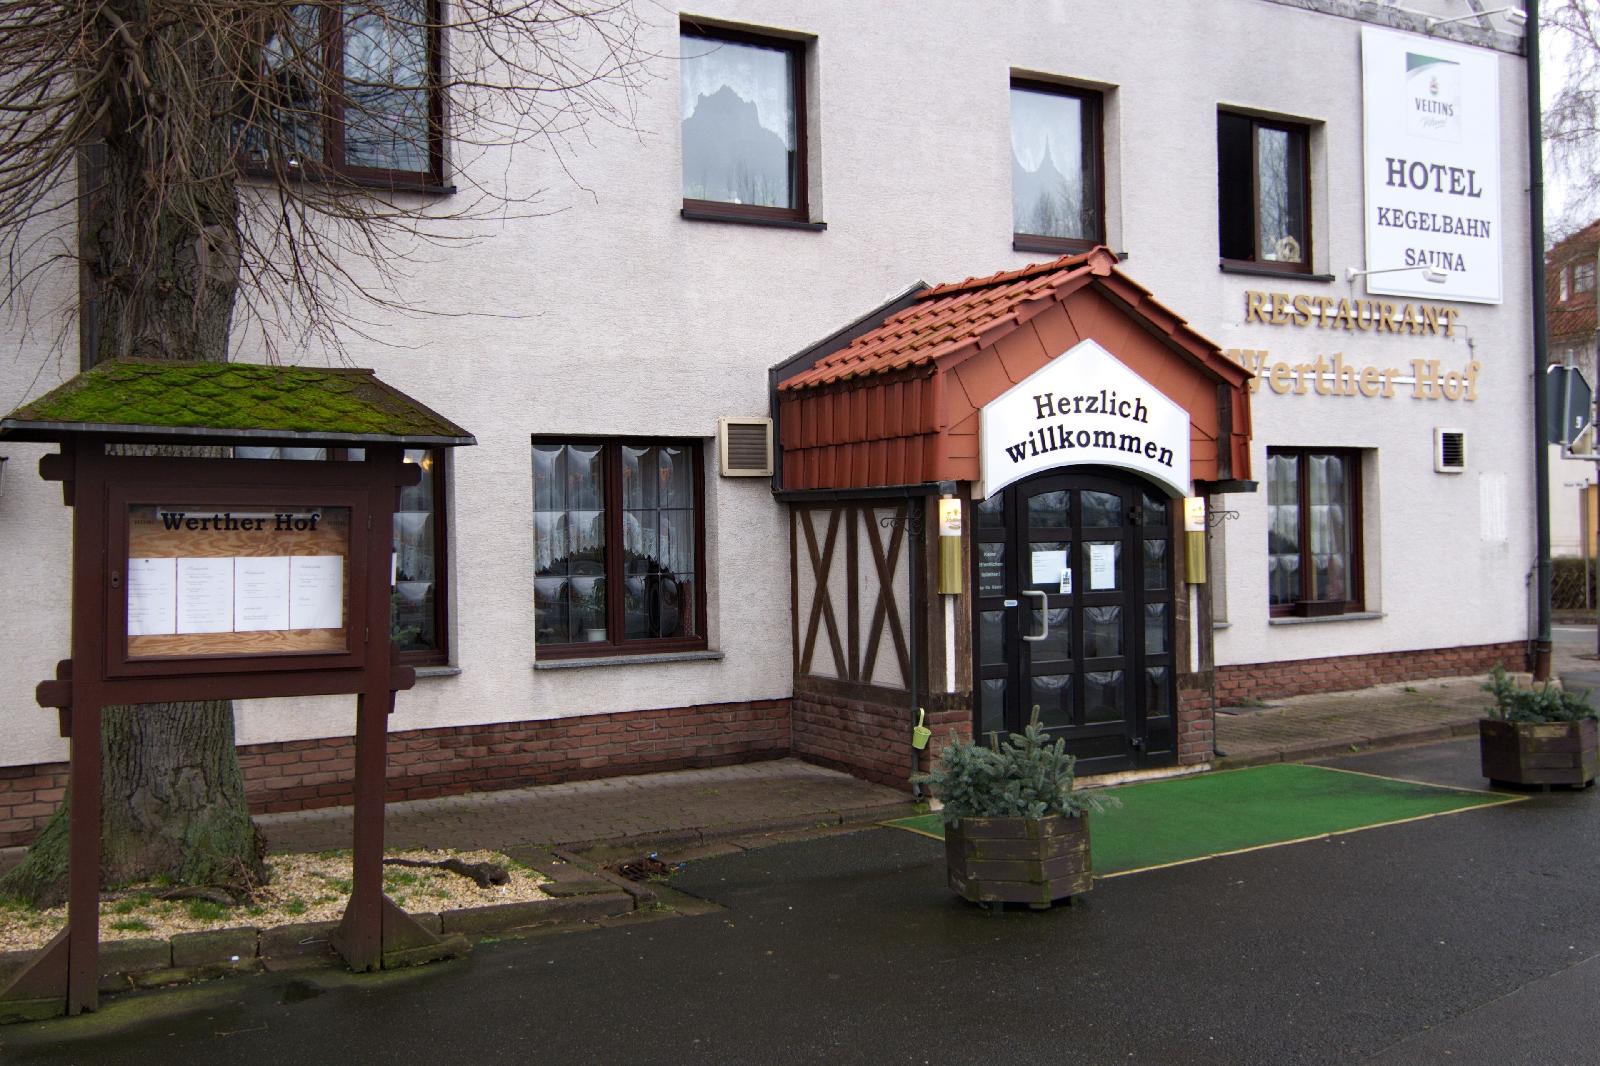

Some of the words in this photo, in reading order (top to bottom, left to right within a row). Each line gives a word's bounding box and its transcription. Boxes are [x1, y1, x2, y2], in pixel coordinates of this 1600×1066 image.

[1415, 97, 1454, 117] VELTINS
[1385, 157, 1482, 198] HOTEL
[1377, 206, 1491, 239] KEGELBAHN
[1405, 248, 1466, 272] SAUNA
[1246, 290, 1460, 337] RESTAURANT
[1411, 358, 1481, 401] Hof
[1033, 389, 1149, 423] Herzlich
[1005, 424, 1175, 467] willkommen
[161, 512, 265, 531] Werther
[274, 513, 321, 531] Hof
